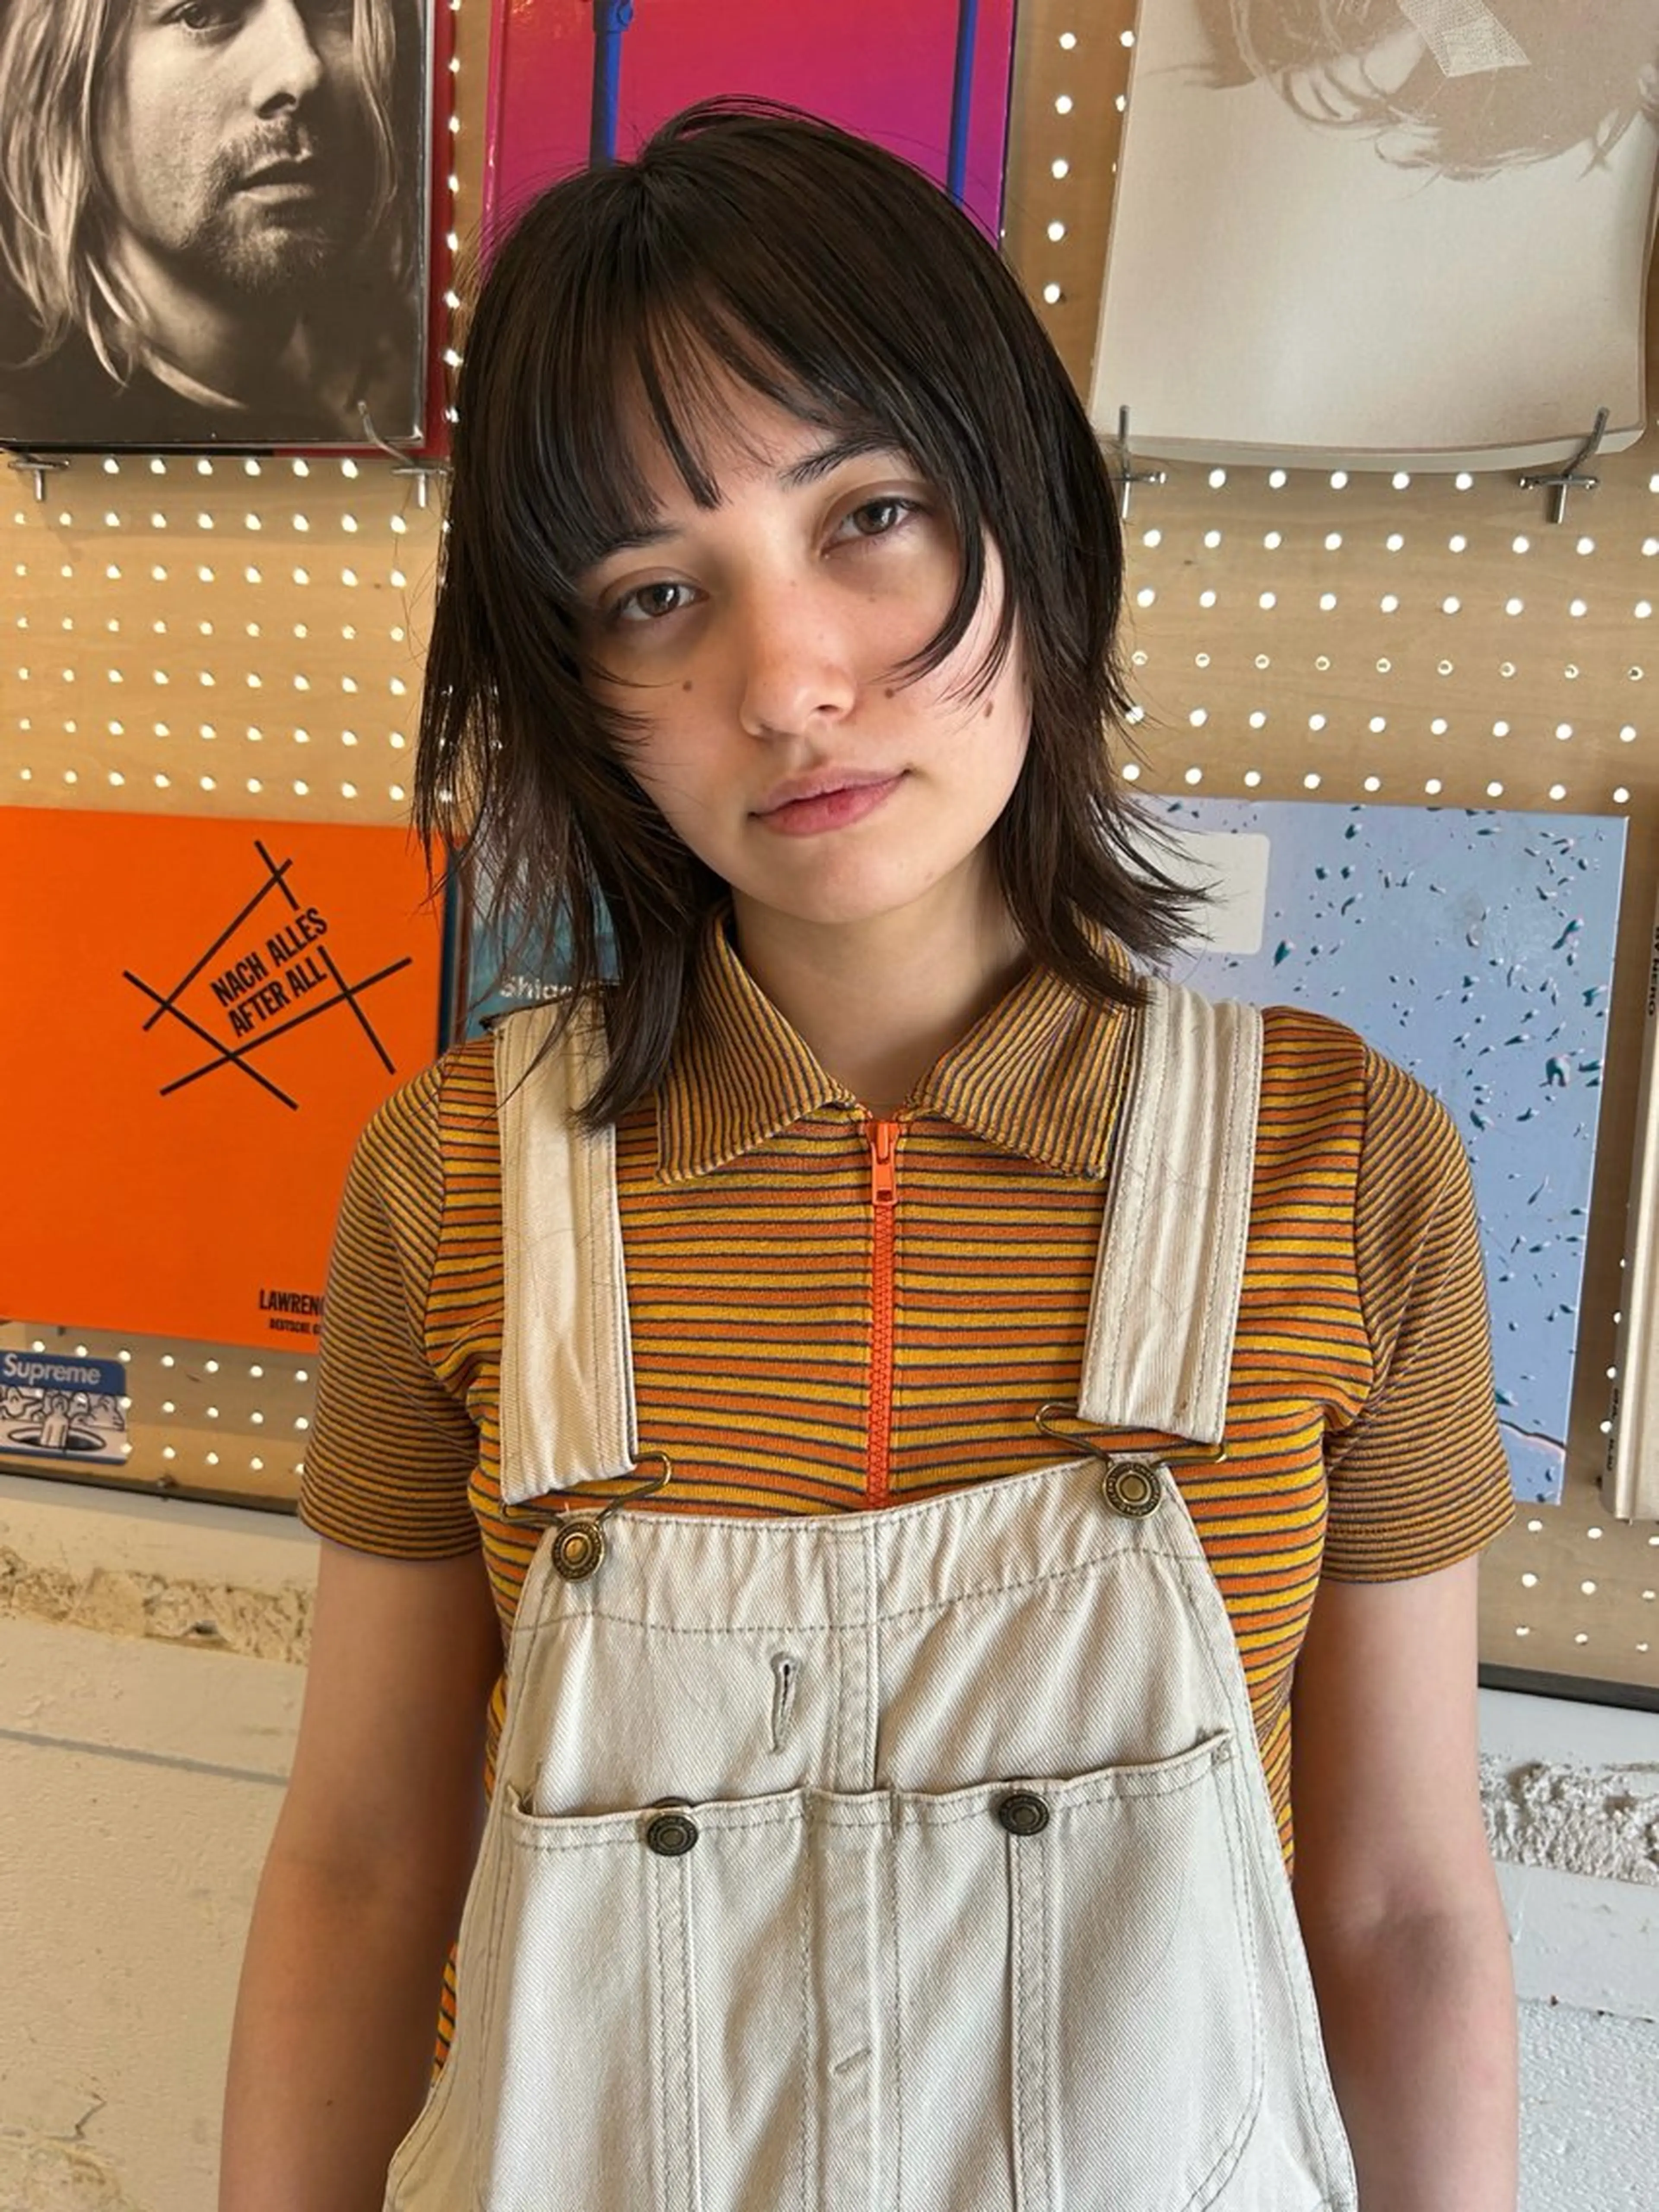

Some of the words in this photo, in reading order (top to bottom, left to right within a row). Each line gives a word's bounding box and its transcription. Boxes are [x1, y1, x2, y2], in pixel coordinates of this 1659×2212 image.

[210, 951, 270, 1007] NACH
[265, 907, 327, 968] ALLES
[228, 979, 292, 1037] AFTER
[285, 956, 327, 998] ALL
[3, 1353, 101, 1385] Supreme
